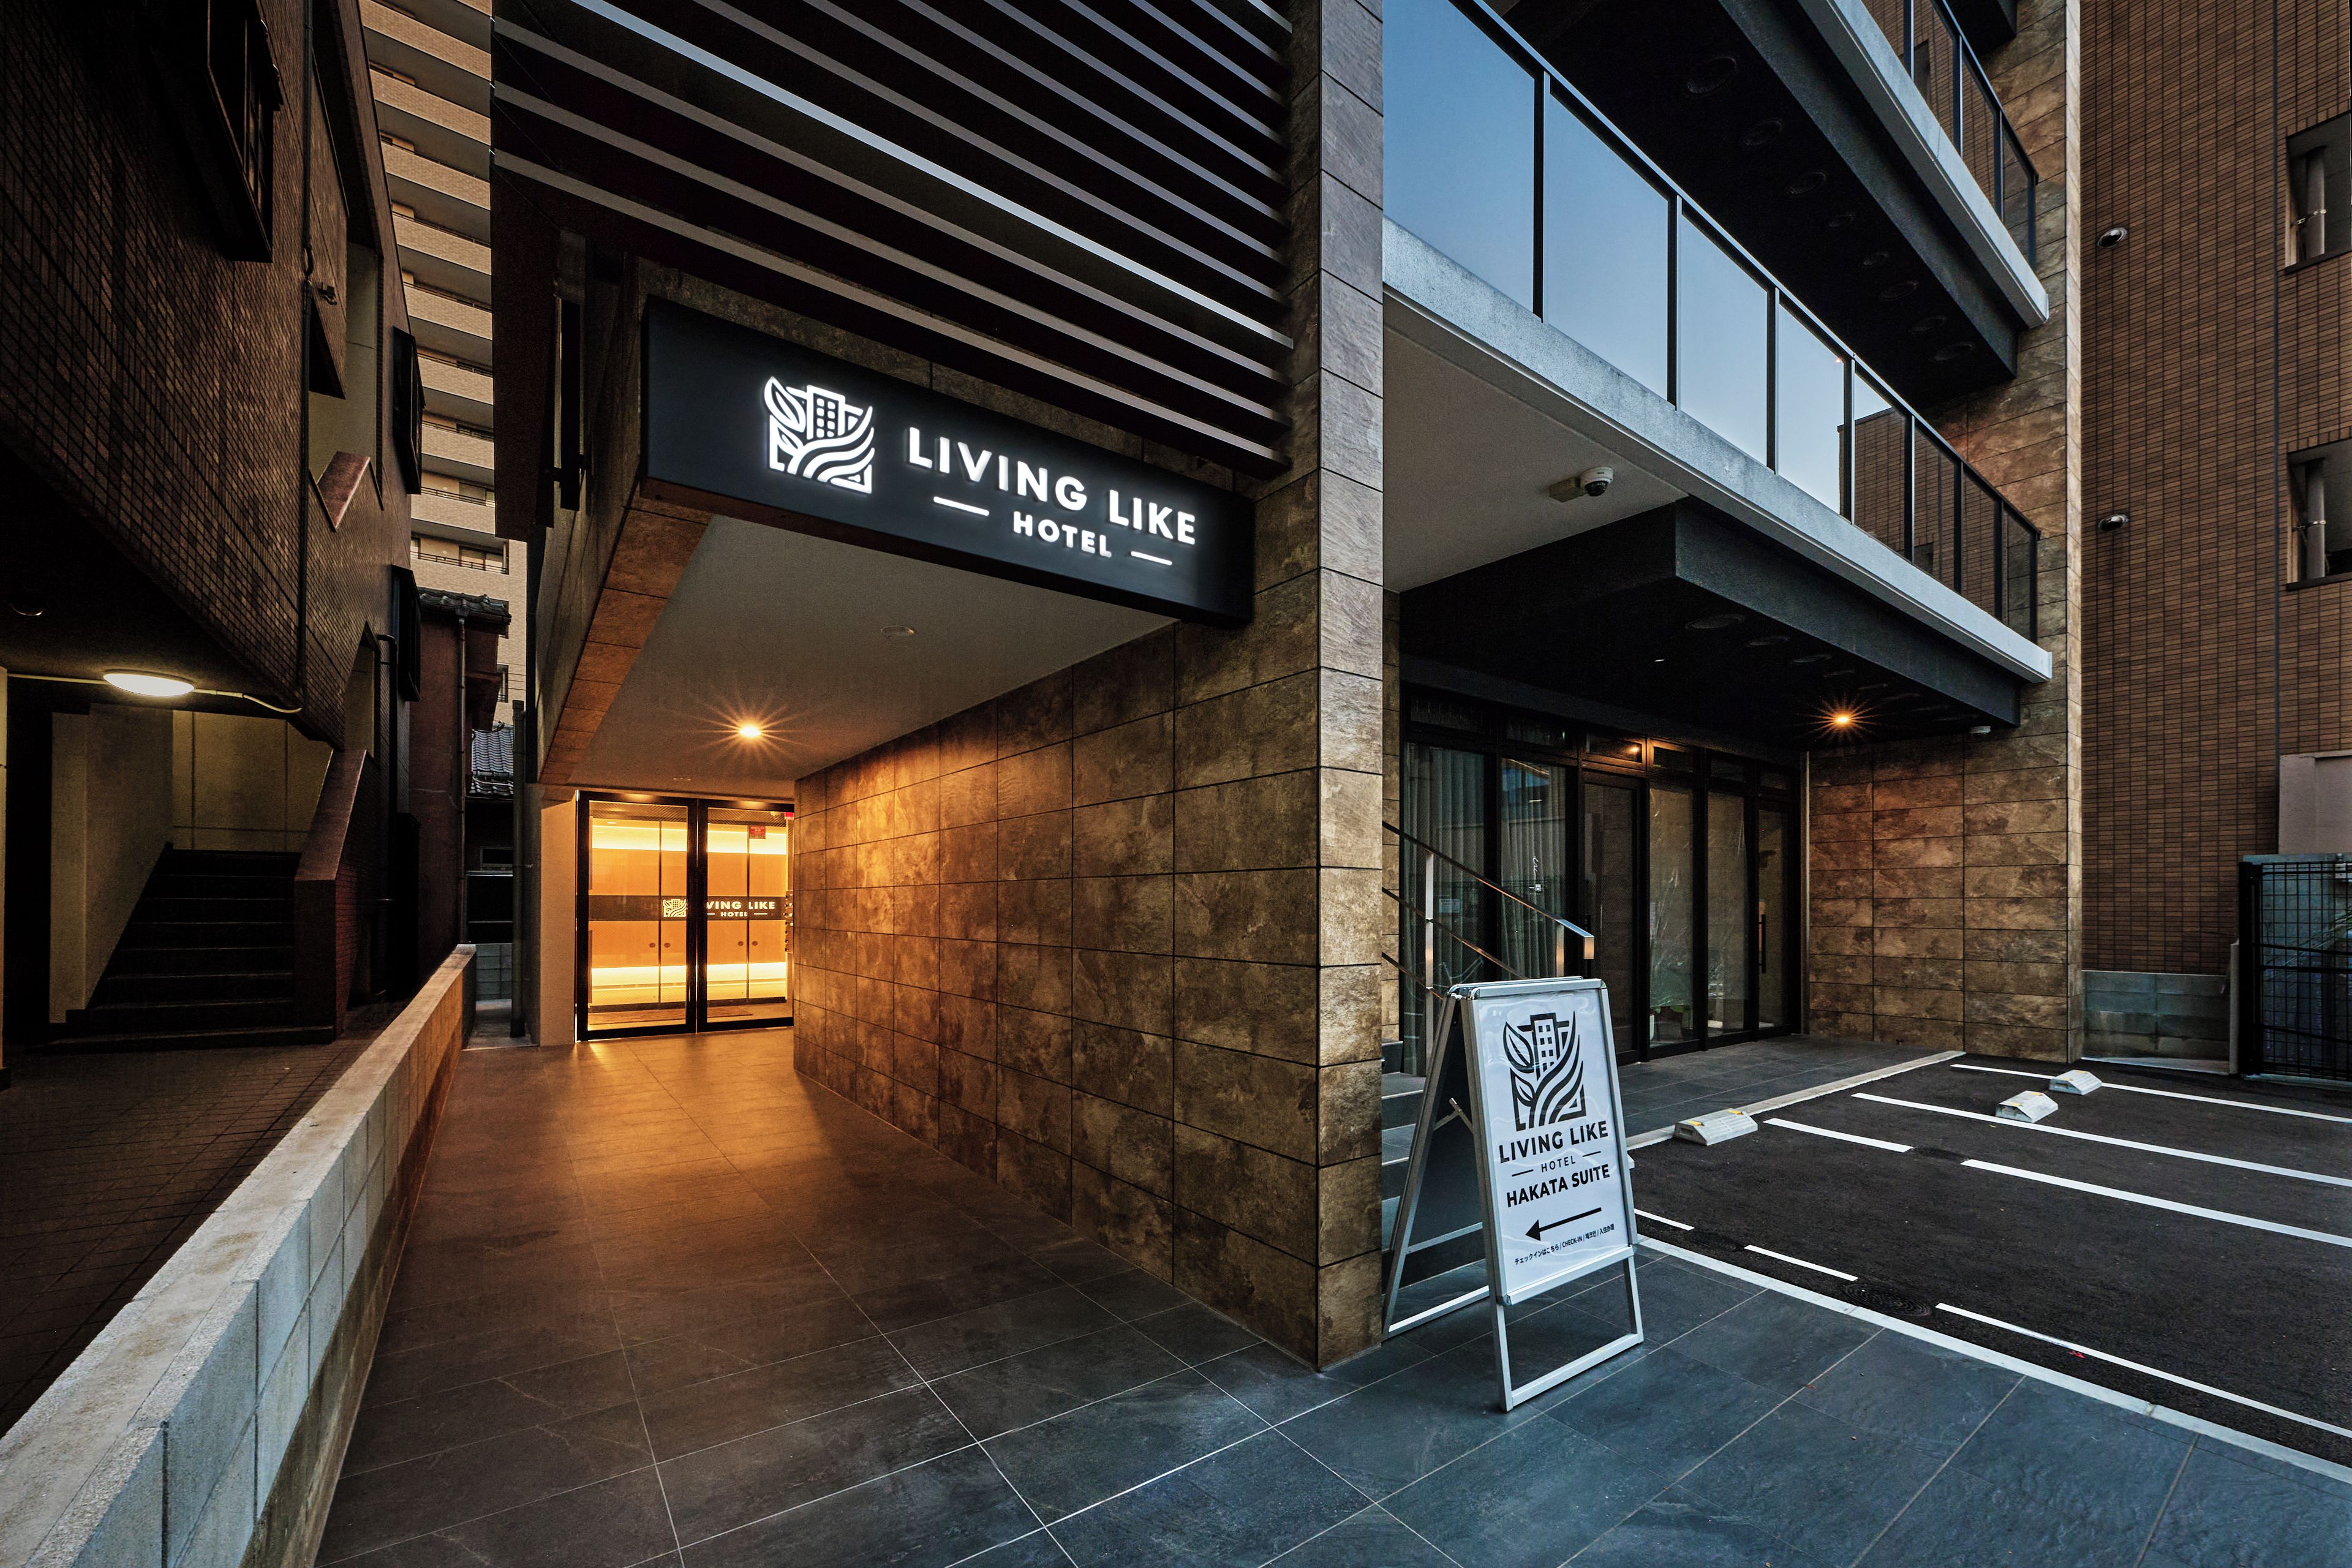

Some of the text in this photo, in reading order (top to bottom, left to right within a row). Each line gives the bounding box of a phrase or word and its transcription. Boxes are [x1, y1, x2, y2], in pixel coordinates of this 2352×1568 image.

[909, 426, 1196, 545] LIVING LIKE
[1013, 510, 1112, 558] HOTEL
[748, 901, 775, 910] LIKE
[1499, 1120, 1608, 1164] LIVING LIKE
[1541, 1155, 1576, 1172] HOTEL
[1506, 1164, 1610, 1208] HAKATA SUITE
[1514, 1244, 1559, 1265] チェックインはこちら
[1562, 1235, 1583, 1248] CHECK-IN
